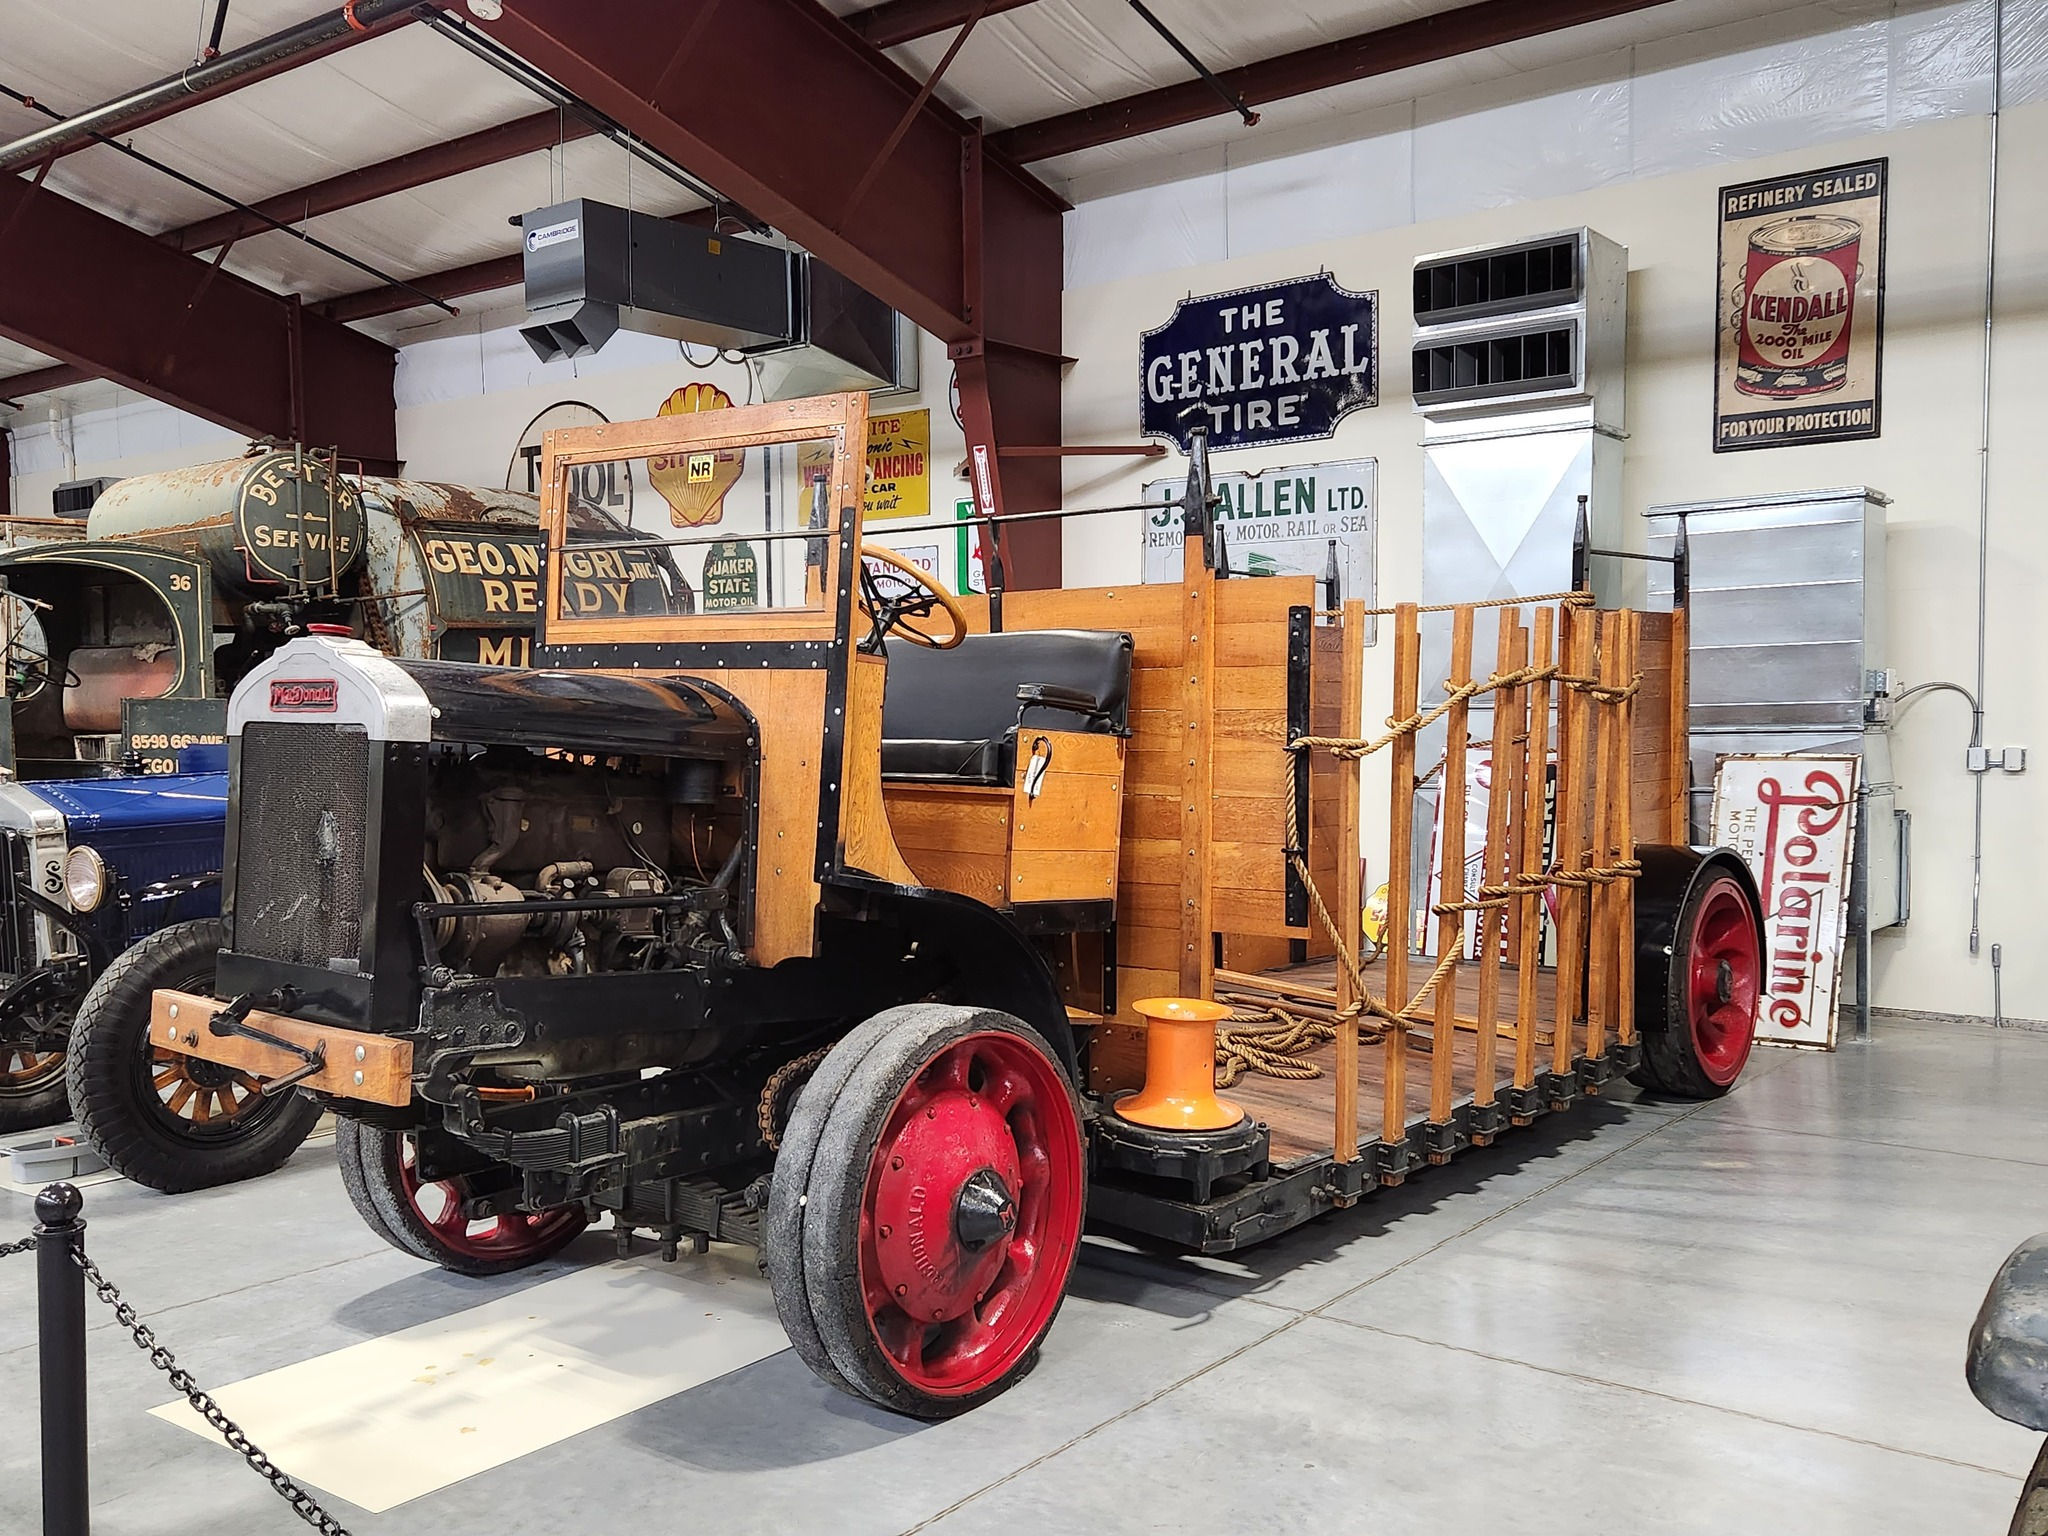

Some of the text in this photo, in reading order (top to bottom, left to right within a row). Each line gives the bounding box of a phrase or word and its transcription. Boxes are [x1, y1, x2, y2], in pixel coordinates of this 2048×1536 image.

[1727, 172, 1877, 213] REFINERY SEALED
[537, 225, 576, 241] CAMBRIDGE
[1219, 299, 1285, 333] THE
[1750, 287, 1847, 323] KENDALL
[1755, 334, 1796, 347] 2000
[1781, 324, 1807, 336] The
[1147, 323, 1369, 403] GENERAL
[1781, 348, 1804, 359] OIL
[1208, 395, 1300, 434] TIRE
[1721, 408, 1872, 439] FOR YOUR PROTECTION
[691, 461, 711, 477] NR
[865, 452, 924, 481] ANCING
[250, 463, 352, 511] BETTR
[872, 483, 896, 494] CAR
[876, 494, 902, 511] wait
[1214, 476, 1317, 522] ALLEN
[1328, 486, 1368, 512] LTD.
[1287, 517, 1319, 537] RAIL
[1340, 515, 1368, 533] SEA
[170, 573, 192, 591] 36
[709, 578, 751, 595] STATE
[705, 597, 755, 608] MOTOR OIL
[273, 686, 331, 705] MacDonald
[131, 734, 168, 749] 8598
[1743, 806, 1758, 833] THE
[1470, 863, 1479, 893] CONSULT
[1758, 770, 1845, 1028] Polarine
